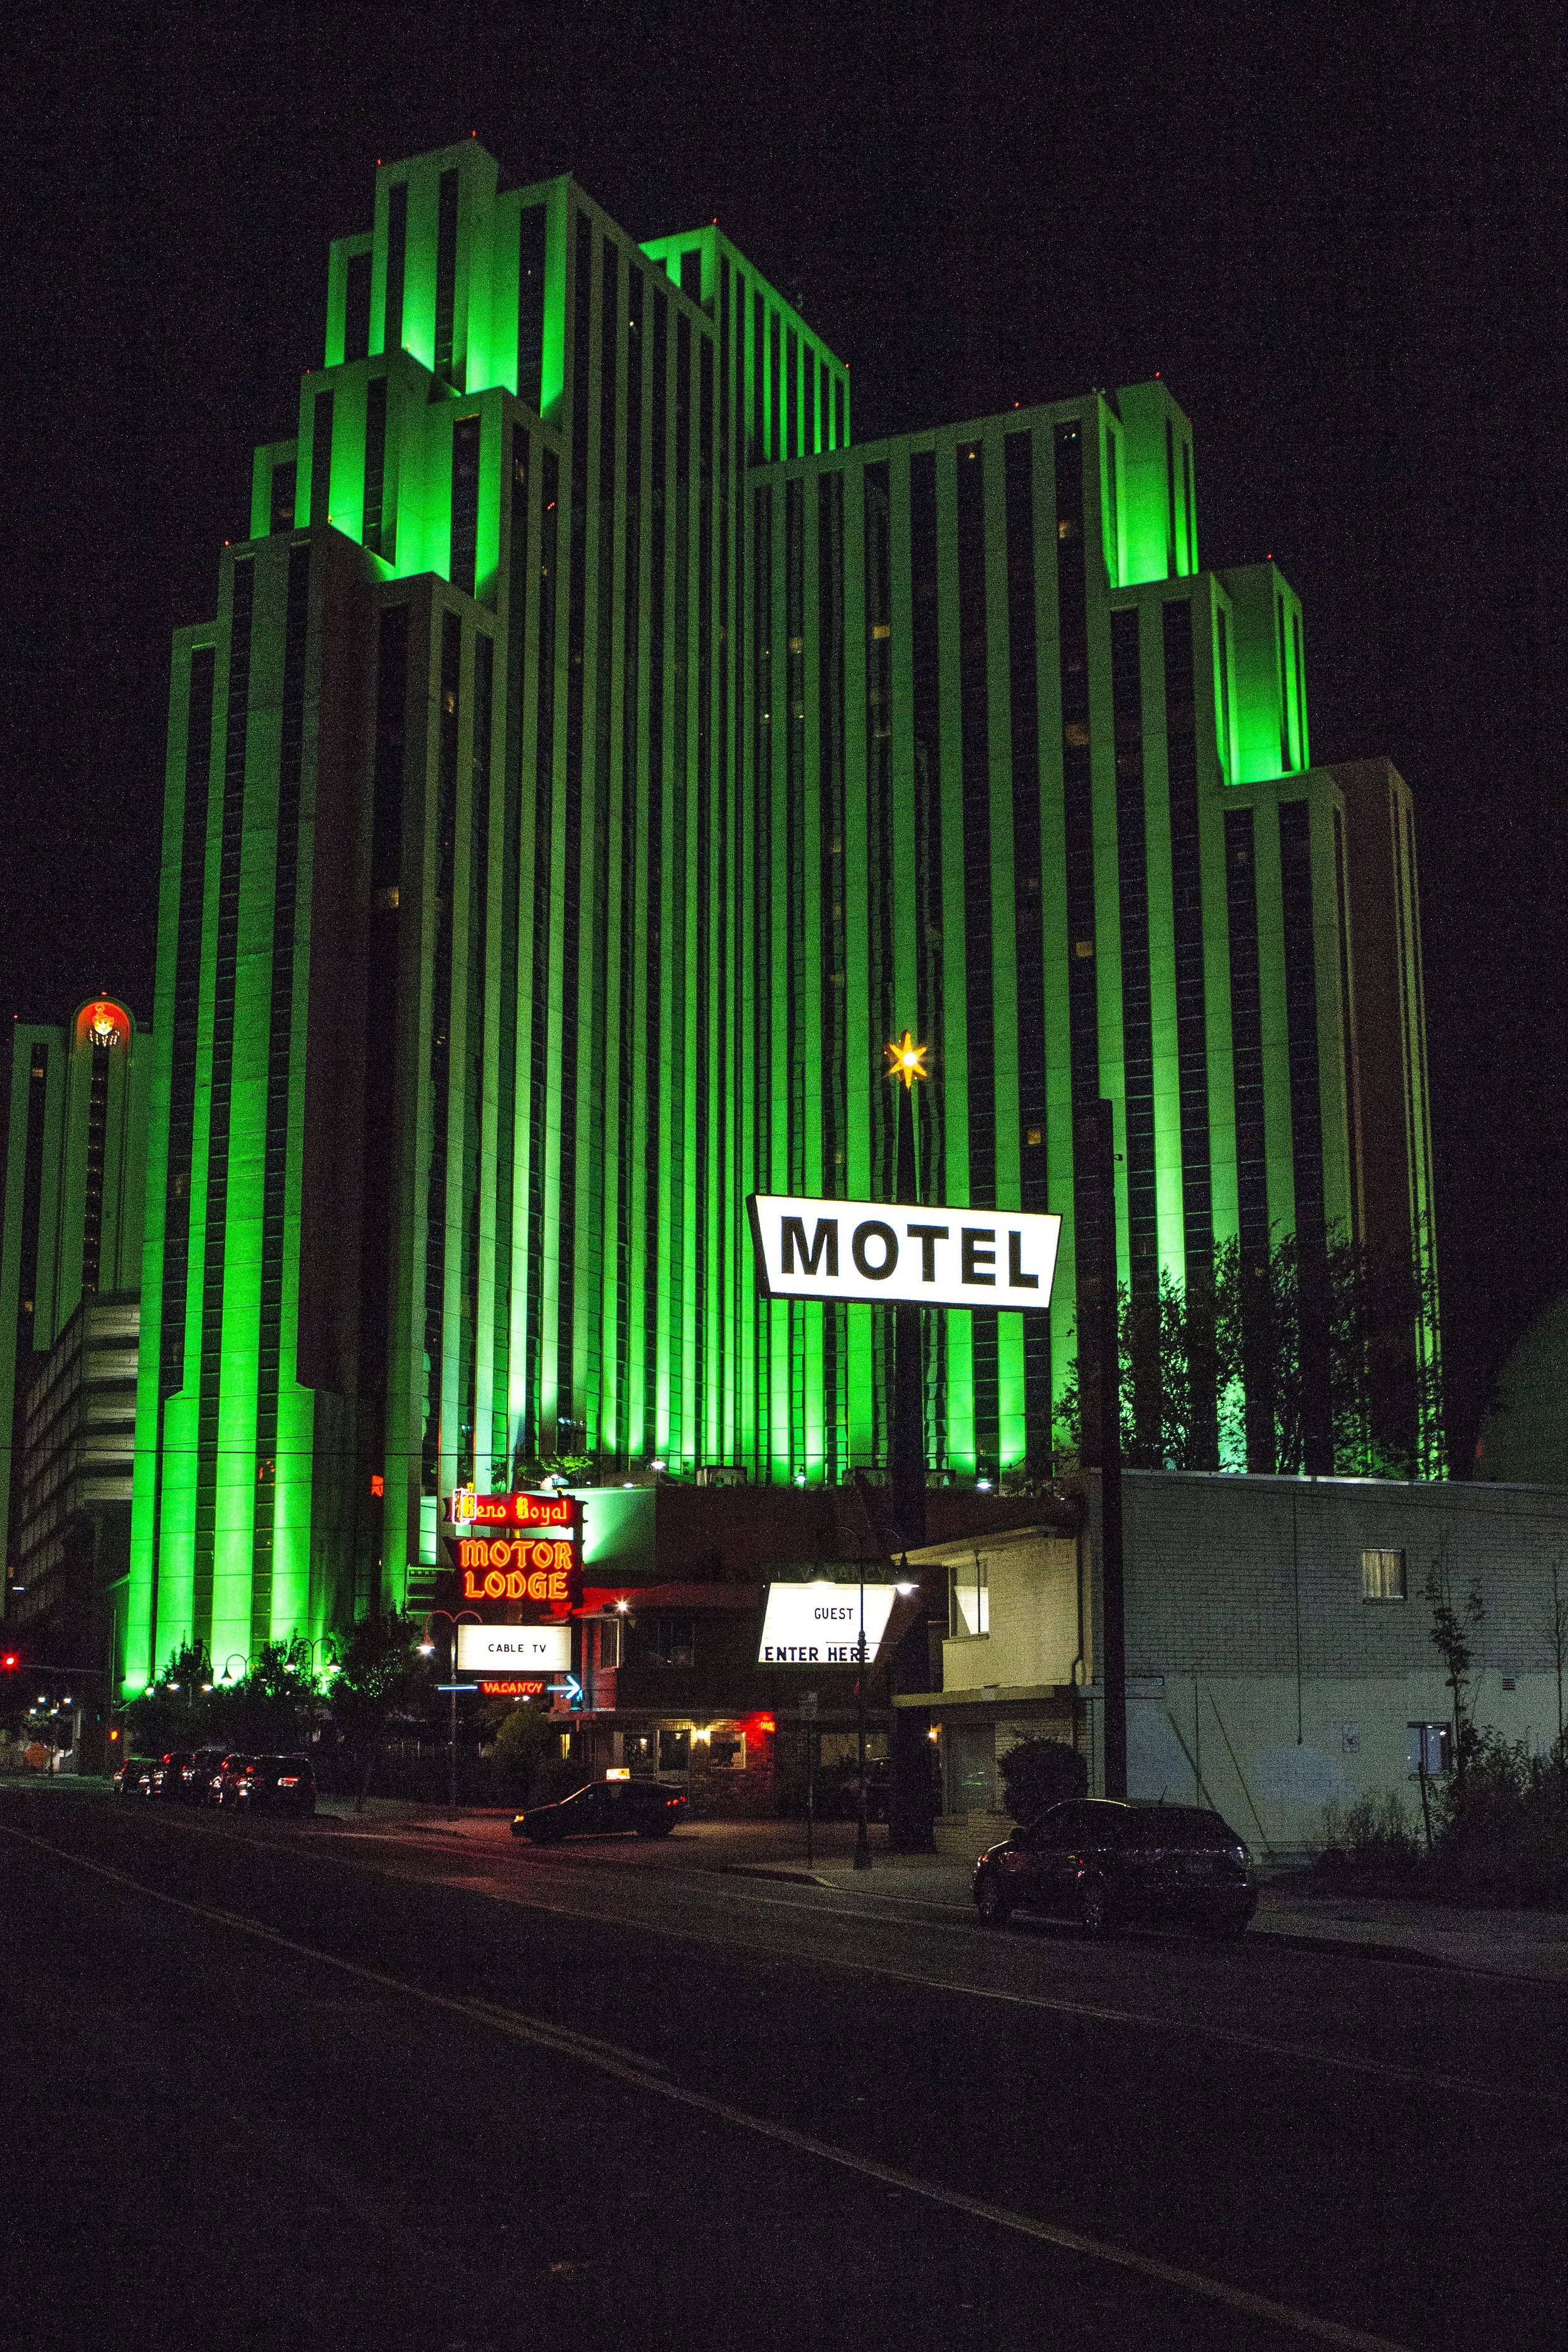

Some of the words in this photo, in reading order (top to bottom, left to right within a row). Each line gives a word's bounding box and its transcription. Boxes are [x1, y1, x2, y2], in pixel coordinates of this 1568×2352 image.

[780, 1215, 1039, 1289] MOTEL
[462, 1495, 507, 1518] Reno
[516, 1496, 568, 1526] Royal
[460, 1540, 572, 1570] MOTOR
[465, 1570, 569, 1600] LODGE
[814, 1607, 854, 1620] GUEST
[488, 1644, 524, 1653] CABLE
[532, 1644, 546, 1653] TV
[764, 1646, 818, 1661] ENTER
[828, 1647, 870, 1662] HERE
[484, 1682, 543, 1693] VACANCY
